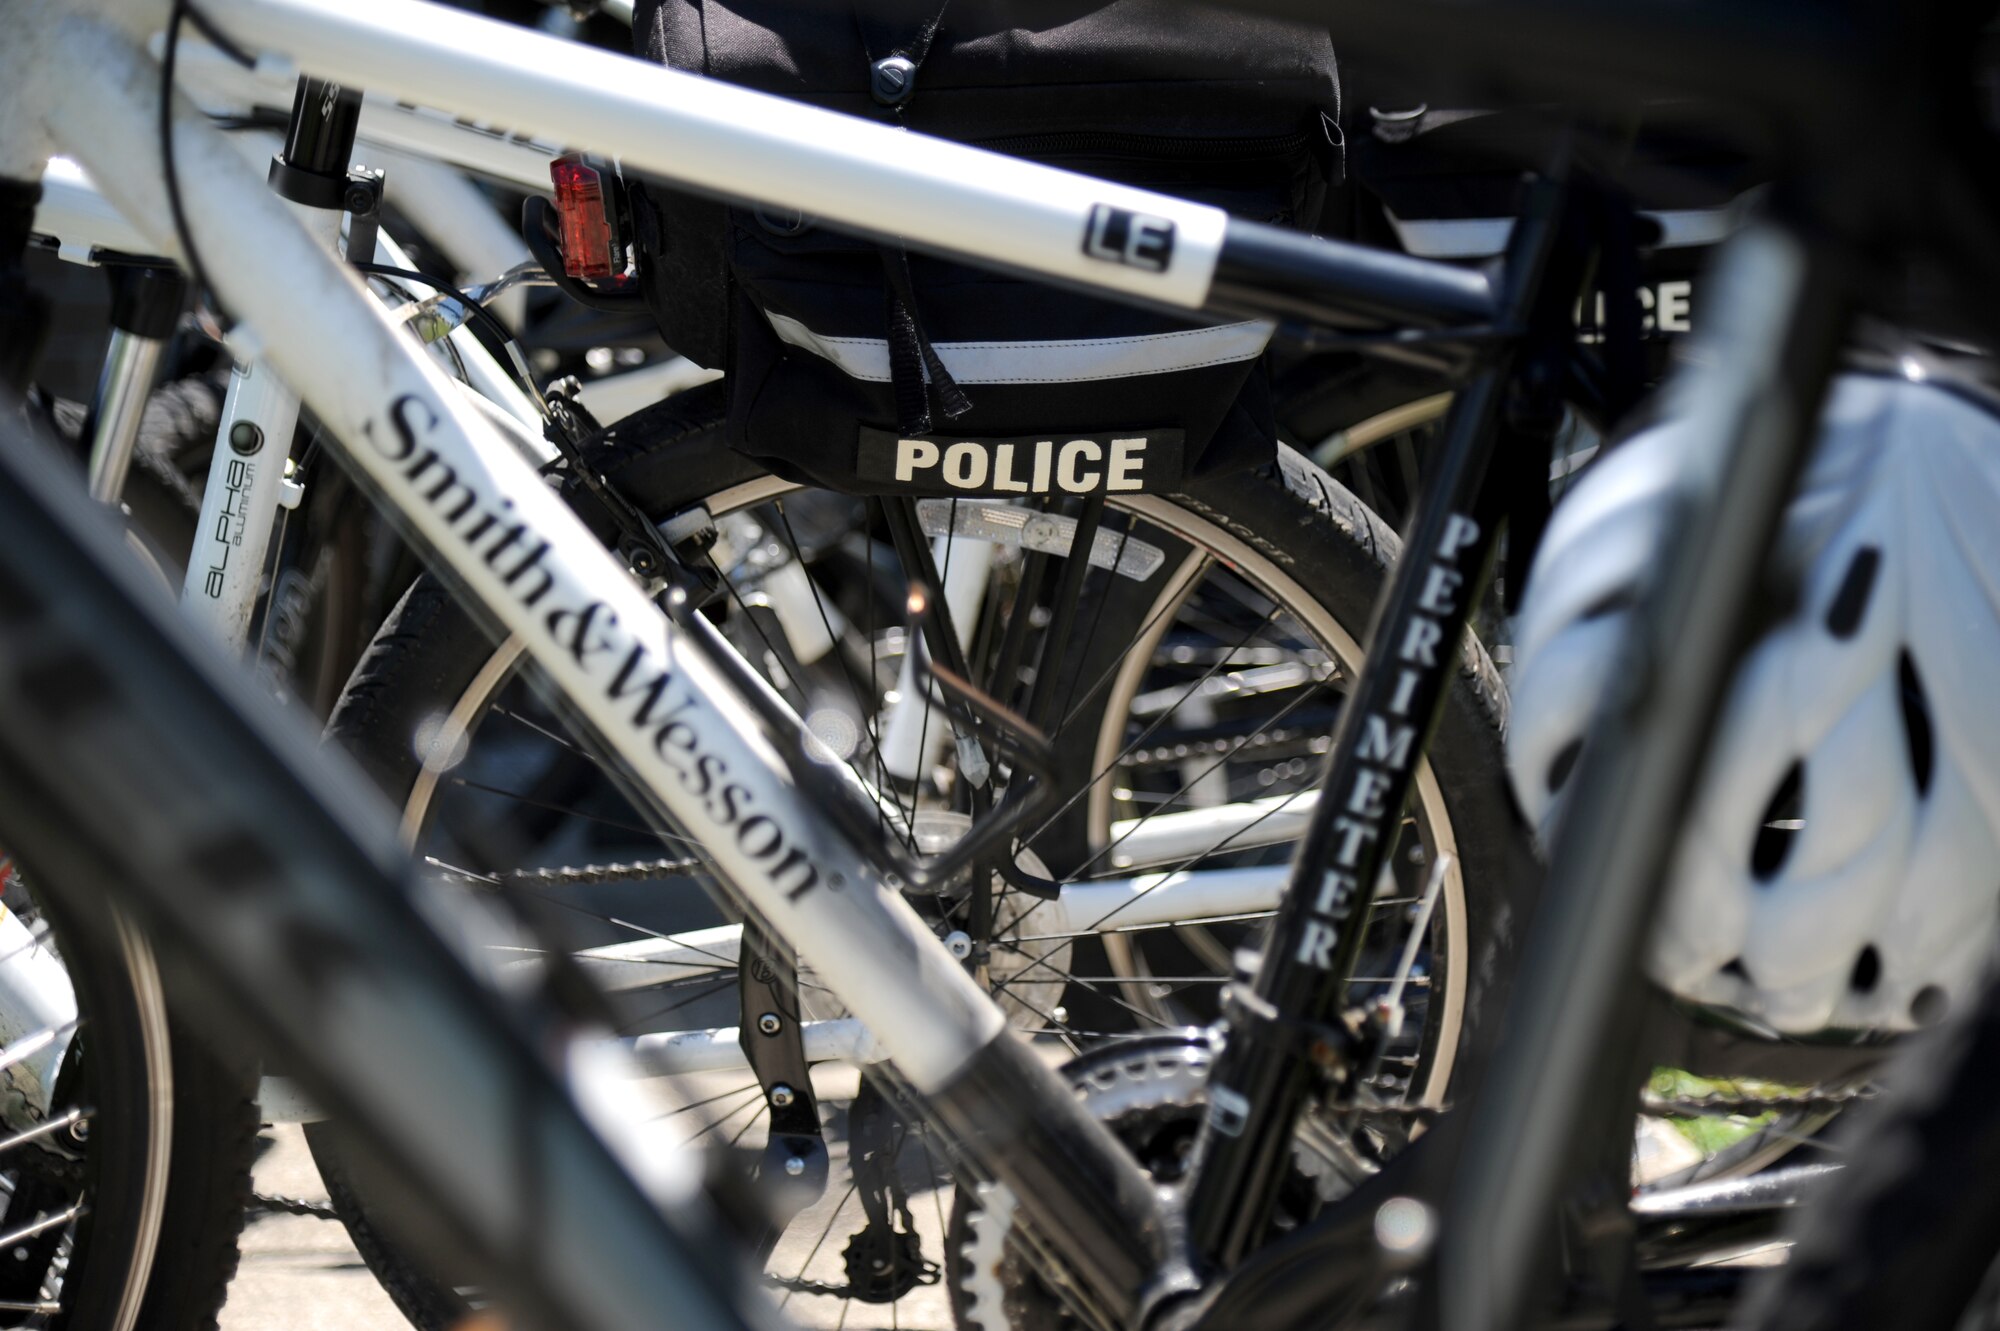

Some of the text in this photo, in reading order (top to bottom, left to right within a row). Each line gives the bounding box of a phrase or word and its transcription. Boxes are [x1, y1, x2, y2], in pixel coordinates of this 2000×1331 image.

[1088, 205, 1172, 270] LE
[895, 437, 1147, 493] POLICE
[1295, 513, 1481, 971] PERIMETER
